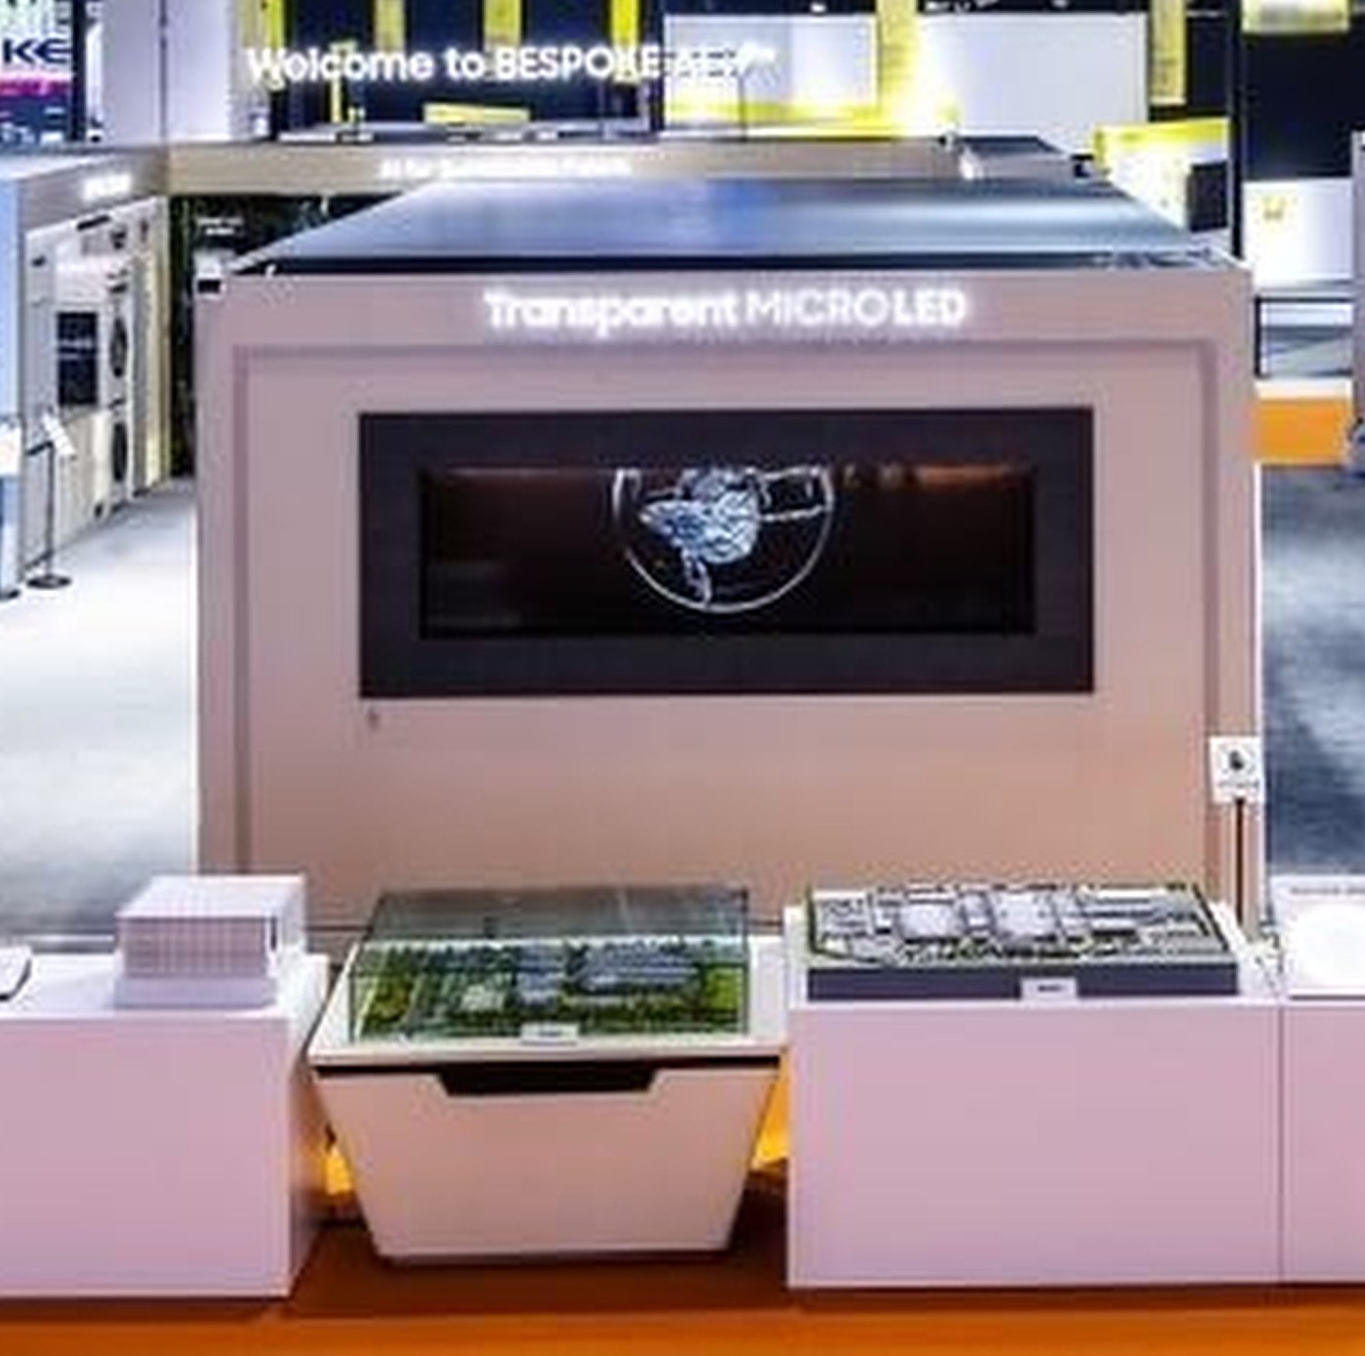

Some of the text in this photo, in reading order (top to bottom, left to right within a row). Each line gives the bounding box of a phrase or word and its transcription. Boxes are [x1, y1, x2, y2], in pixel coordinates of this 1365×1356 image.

[246, 45, 436, 84] Welcome
[445, 47, 485, 82] to
[496, 45, 660, 82] BESPOKE
[484, 289, 736, 338] Transparent
